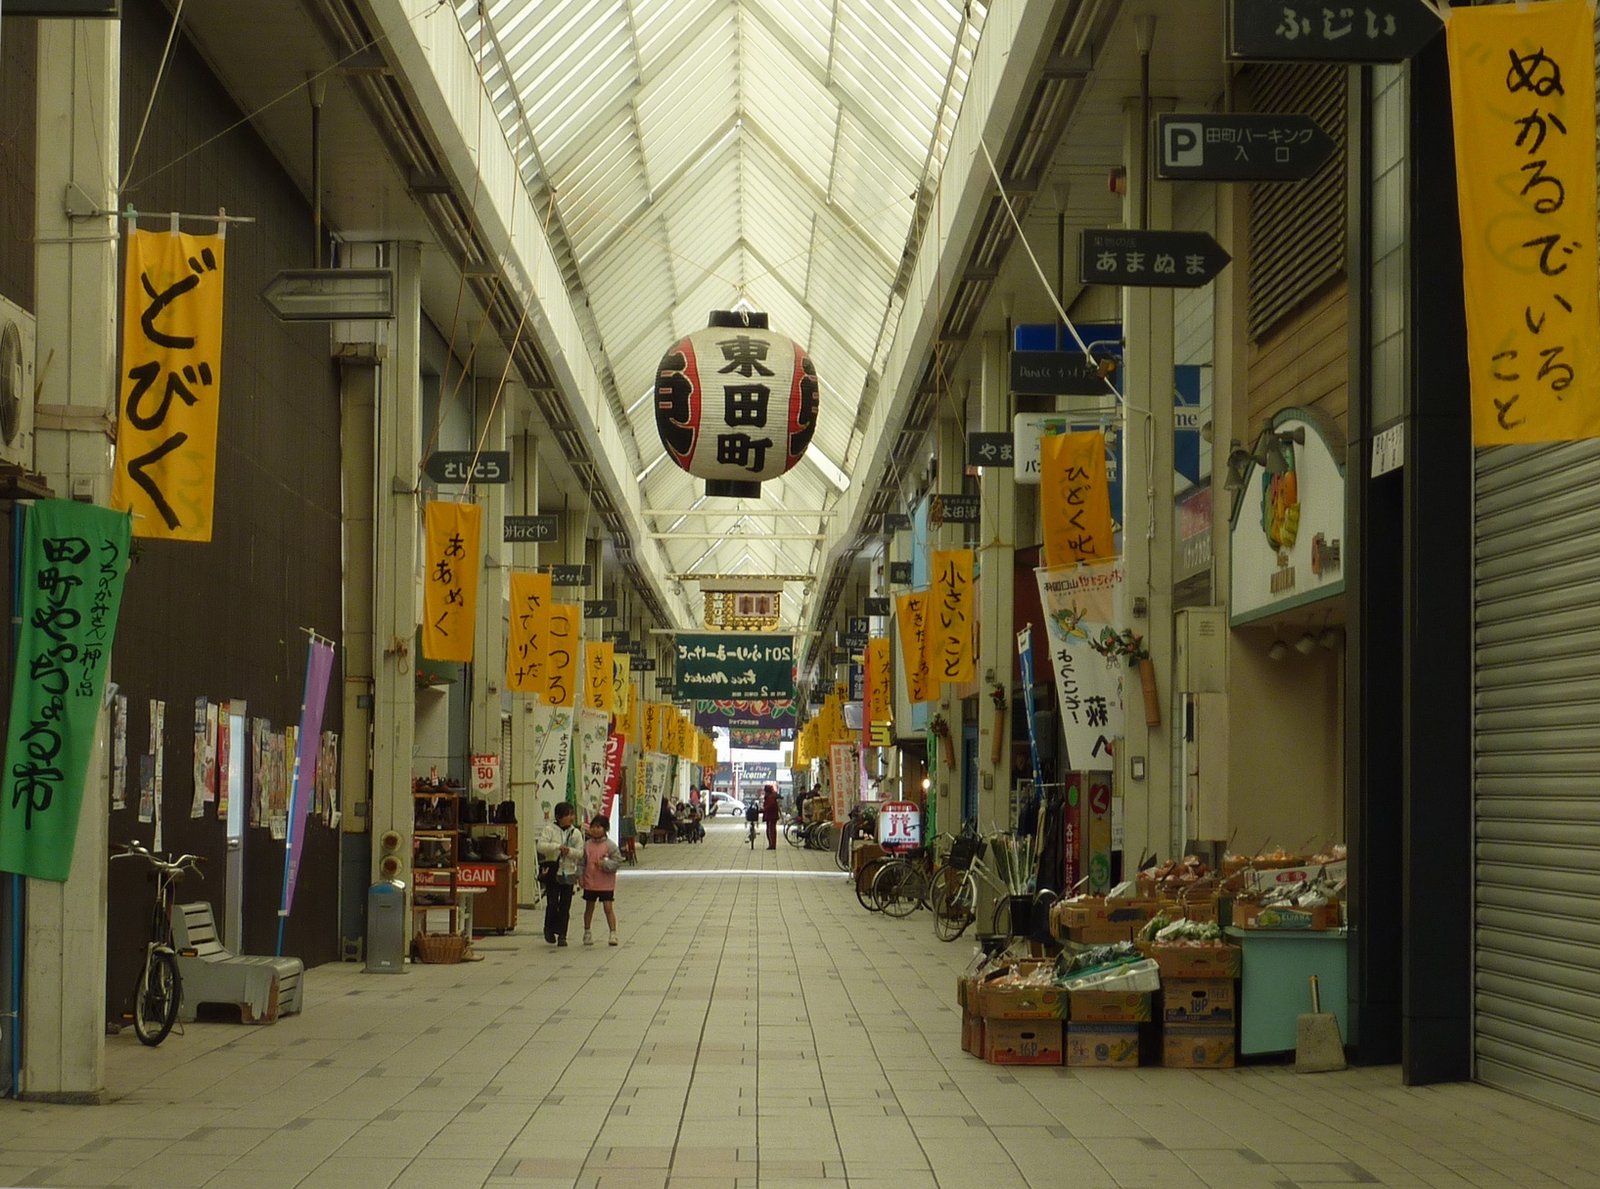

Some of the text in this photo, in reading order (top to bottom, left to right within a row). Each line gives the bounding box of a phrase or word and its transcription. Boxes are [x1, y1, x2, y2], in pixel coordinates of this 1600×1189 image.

[1276, 8, 1397, 39] ふじい
[1171, 128, 1197, 162] P
[1206, 128, 1313, 144] 田町パーキング
[1234, 145, 1290, 162] 入口
[1096, 251, 1206, 274] あまぬま
[126, 247, 217, 531] どびく
[715, 335, 775, 473] 東田町
[1492, 351, 1526, 431] こと
[444, 461, 501, 479] さいとう
[939, 560, 966, 677] 小さいこと
[548, 615, 570, 704] こつる
[12, 536, 91, 831] 田町やっちょる市
[473, 756, 498, 766] SALE
[477, 766, 494, 780] 50
[541, 758, 557, 790] 萩へ
